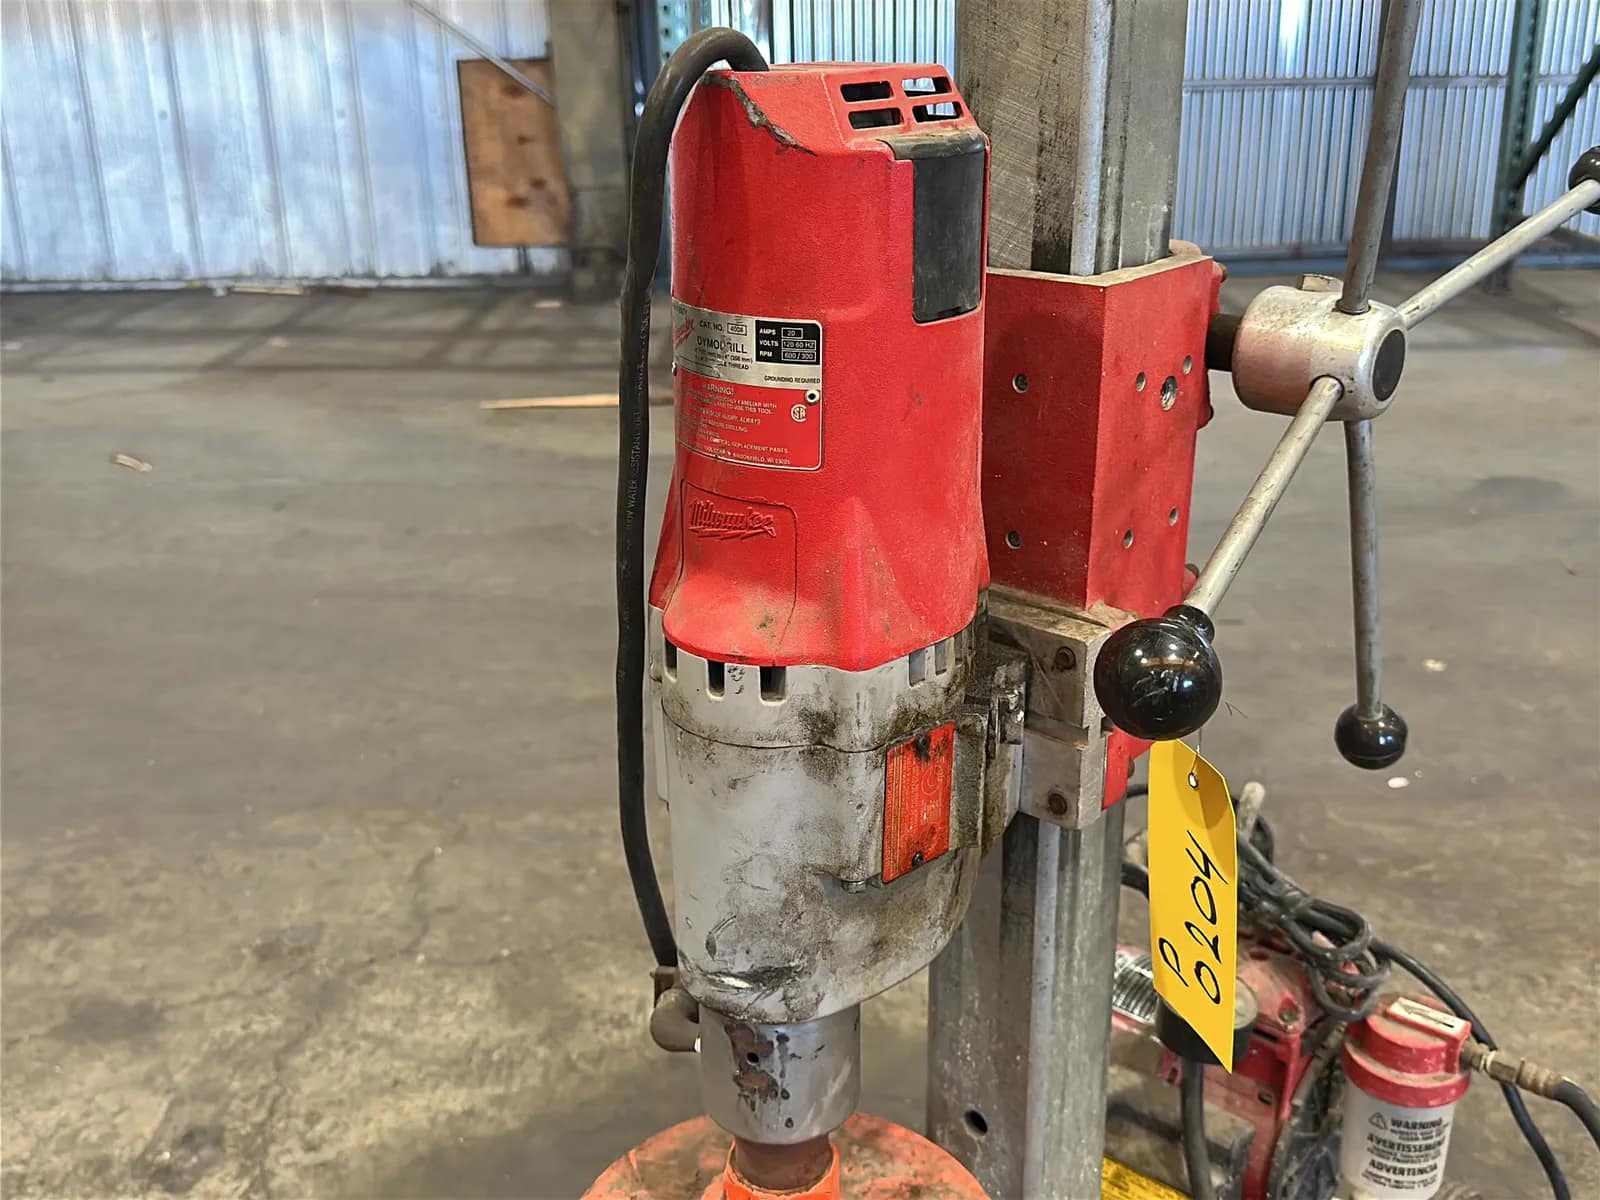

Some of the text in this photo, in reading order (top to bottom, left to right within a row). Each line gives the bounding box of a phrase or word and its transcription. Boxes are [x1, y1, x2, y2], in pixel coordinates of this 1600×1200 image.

[764, 375, 793, 383] GROUNDING
[625, 479, 638, 508] WATER
[688, 498, 776, 534] Milwaukee
[1184, 829, 1230, 1005] 0204
